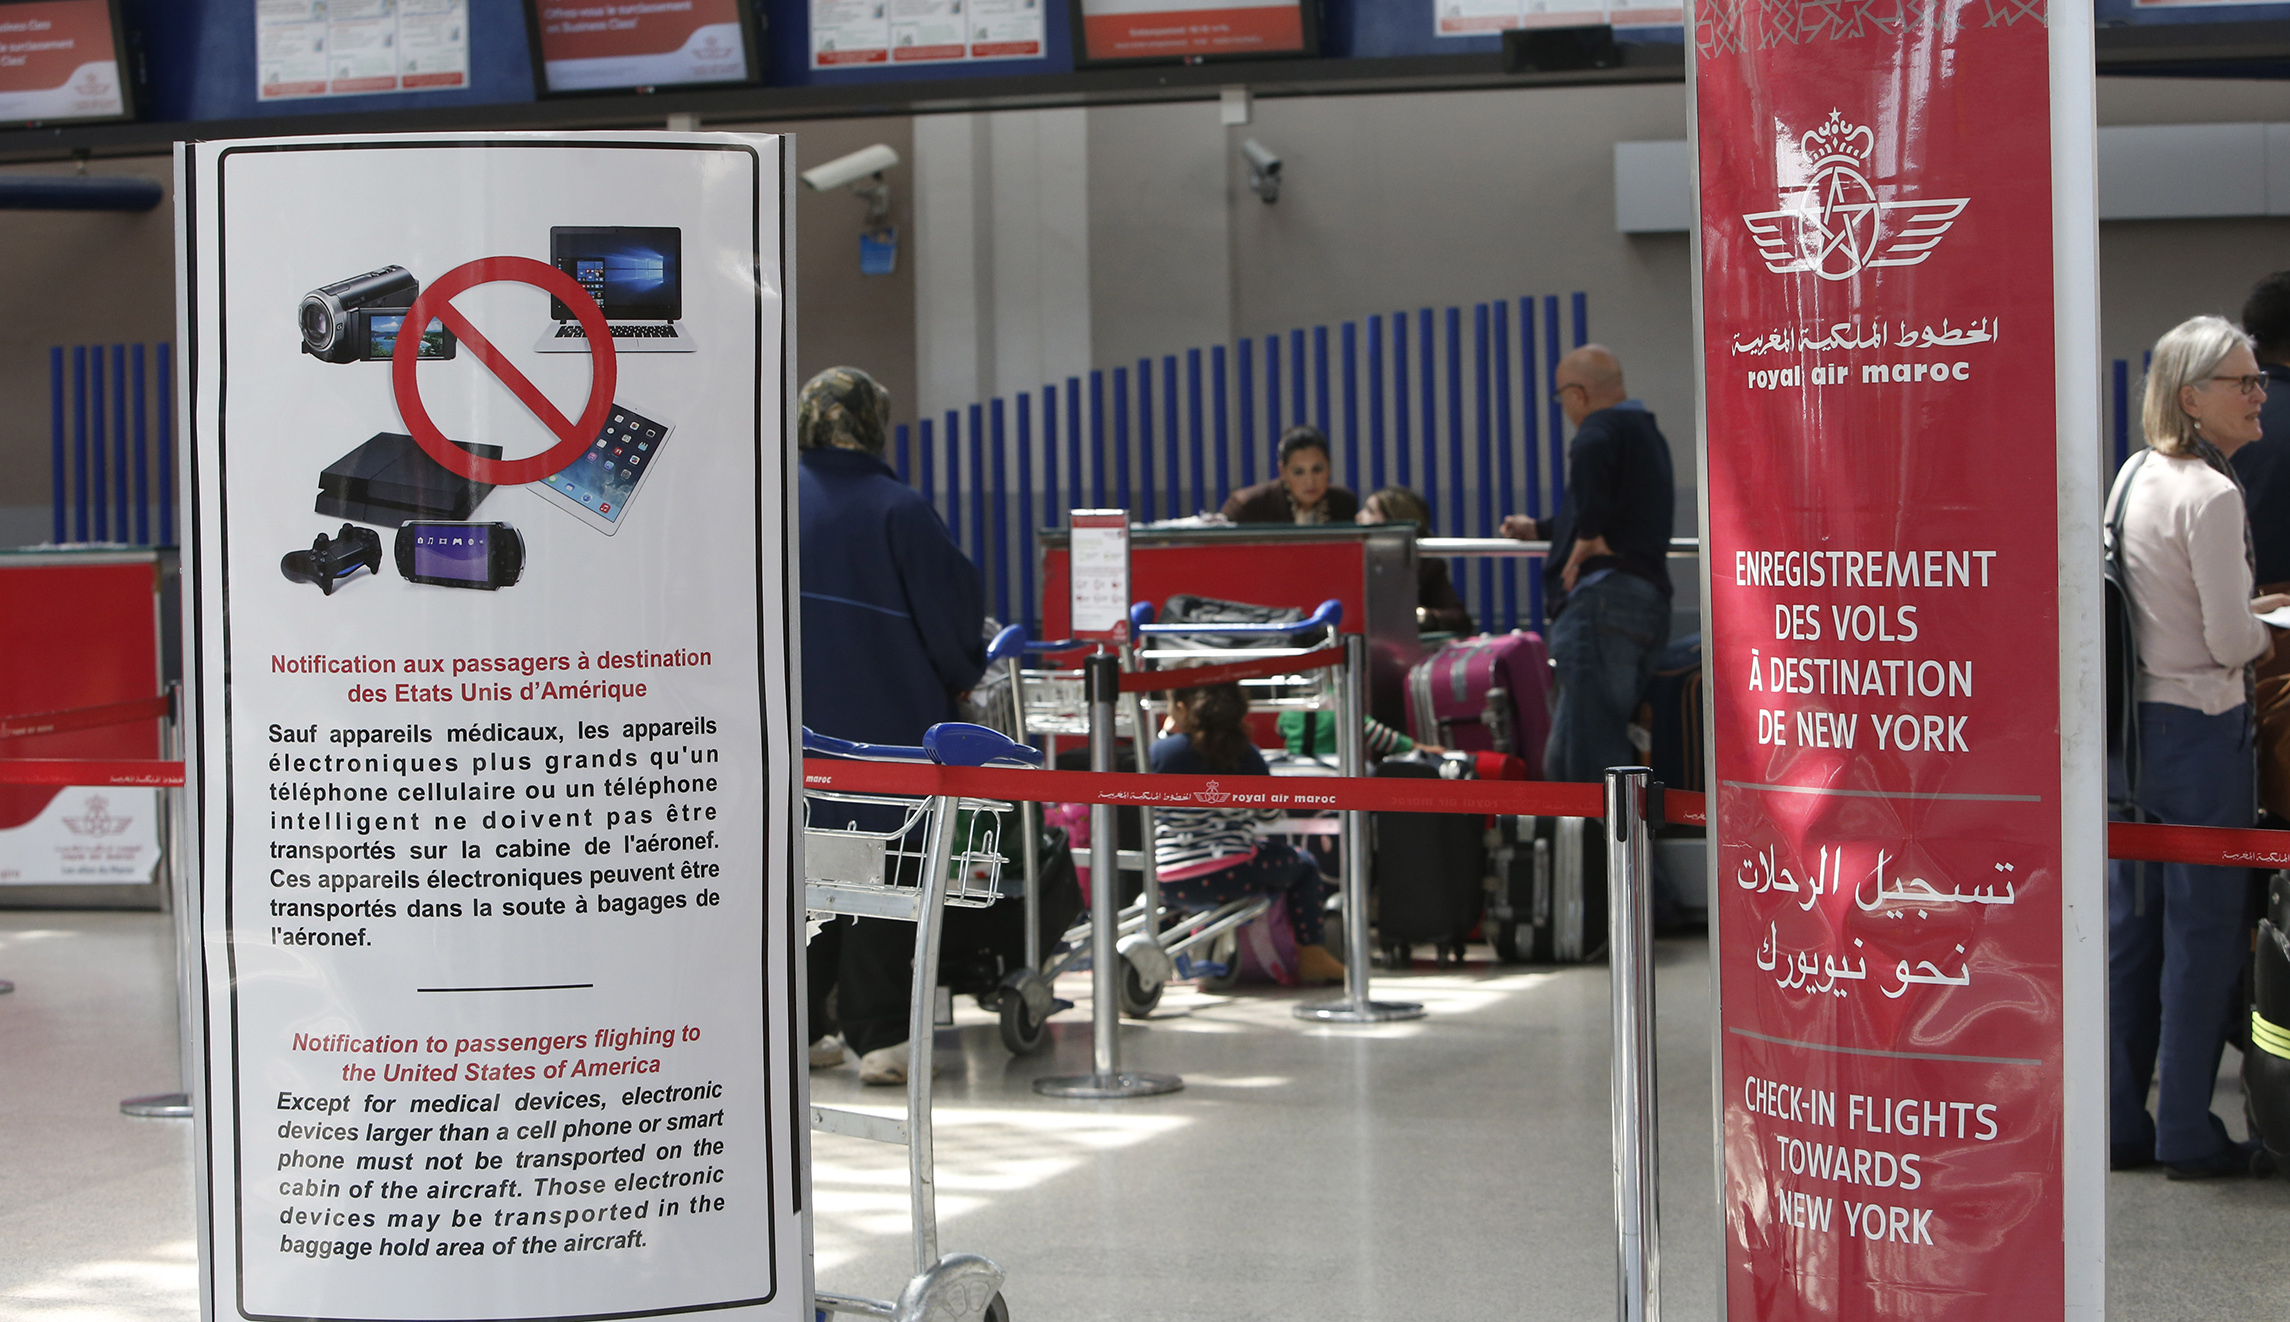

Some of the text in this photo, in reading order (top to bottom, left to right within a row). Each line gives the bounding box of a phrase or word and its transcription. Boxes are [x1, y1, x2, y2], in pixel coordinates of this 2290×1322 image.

[1732, 316, 1998, 356] الخطوط الملكية المغربية
[1748, 361, 1969, 390] royal air maroc
[1735, 550, 1997, 587] ENREGISTREMENT
[1775, 604, 1919, 643] DES VOLS
[272, 648, 711, 677] Notification aux passagers à destination
[1748, 648, 1972, 697] À DESTINATION
[348, 680, 647, 702] des Etats Unis d’Amérique
[269, 716, 717, 747] Sauf appareils médicaux, les appareils
[1758, 709, 1969, 753] DE NEW YORK
[269, 746, 718, 776] électroniques plus grands qu'un
[270, 776, 717, 805] téléphone cellulaire ou un téléphone
[805, 775, 832, 784] maroc
[1232, 793, 1336, 804] royal air maroc
[271, 804, 716, 835] intelligent ne doivent pas être
[270, 830, 718, 863] transportés sur la cabine de l'aéronef.
[270, 860, 719, 892] Ces appareils électroniques peuvent être
[1737, 844, 2014, 920] تسجيل الرحلات
[270, 888, 720, 921] transportés dans la soute à bagages de
[272, 927, 371, 946] l'aéronef.
[1756, 920, 1970, 998] نحو نيويورك
[293, 1025, 700, 1057] Notification to passengers flighing to
[343, 1056, 660, 1082] the United States of America
[277, 1081, 722, 1116] Except for medical devices, electronic
[1745, 1076, 1998, 1141] CHECK-IN FLIGHTS
[278, 1109, 724, 1146] devices larger than a cell phone or smart
[278, 1138, 723, 1171] phone must not be transported on the
[1776, 1134, 1922, 1190] TOWARDS
[280, 1166, 724, 1199] cabin of the aircraft. Those electronic
[280, 1195, 724, 1232] devices may be transported in the
[1779, 1189, 1934, 1246] NEW YORK
[280, 1230, 646, 1260] baggage hold area of the aircraft.
